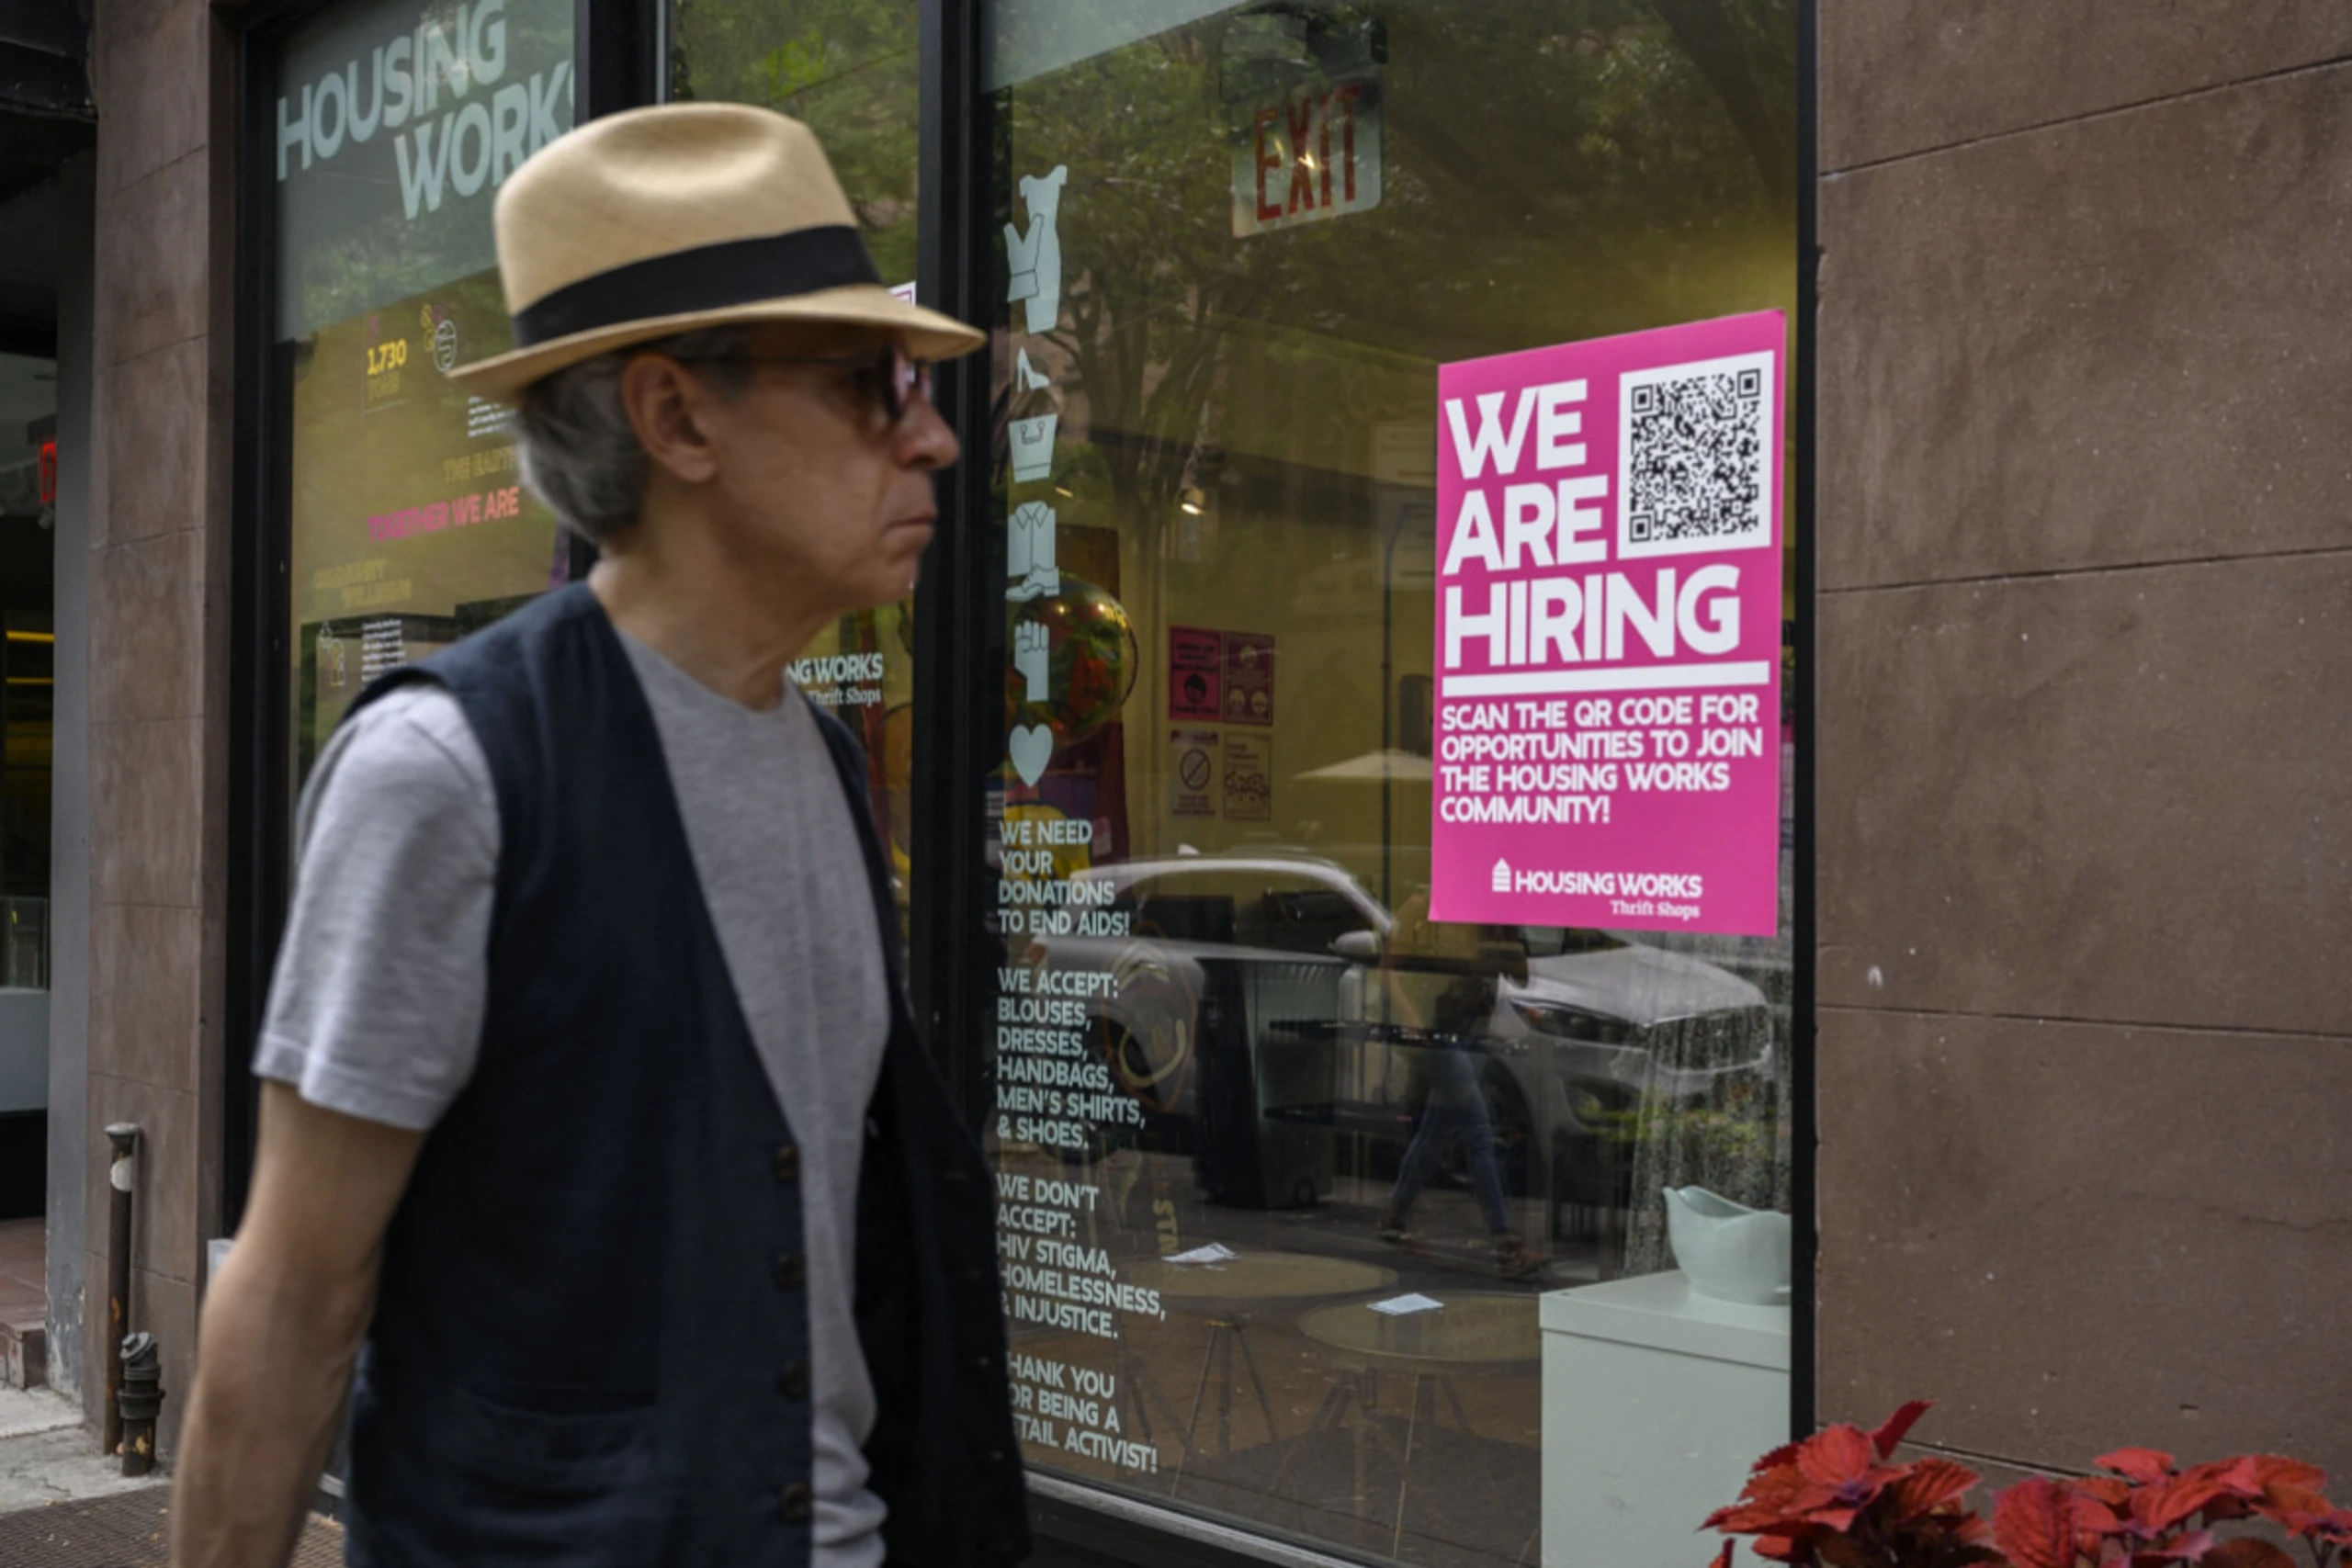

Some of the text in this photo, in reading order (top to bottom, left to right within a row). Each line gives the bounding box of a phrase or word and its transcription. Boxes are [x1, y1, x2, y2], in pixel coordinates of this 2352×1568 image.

[277, 0, 506, 182] HOUSING
[394, 61, 574, 220] WORK
[1254, 84, 1361, 221] EXIT
[1444, 378, 1588, 480] WE
[452, 494, 482, 526] WE
[484, 486, 520, 521] ARE
[1442, 474, 1608, 575] ARE
[1444, 564, 1740, 669] HIRING
[815, 651, 883, 683] WORKS
[846, 687, 881, 707] Shops
[1442, 694, 1758, 730] SCAN THE QR CODE FOR
[1441, 728, 1762, 761] OPPORTUNITIES TO JOIN
[1441, 762, 1730, 792] THE HOUSING WORKS
[1441, 795, 1610, 823] COMMUNITY!
[999, 820, 1092, 845] WE NEED
[1000, 851, 1053, 875] YOUR
[999, 880, 1114, 906] DONATIONS
[1515, 871, 1702, 898] HOUSING WORKS
[998, 909, 1130, 936] TO END AIDS!
[1611, 900, 1700, 921] Thrift Shops
[998, 967, 1118, 998] WE ACCEPT:
[998, 998, 1091, 1030] BLOUSES,
[998, 1027, 1088, 1059] DRESSES,
[997, 1055, 1114, 1093] HANDBAGS,
[1067, 1094, 1146, 1128] SHIRTS,
[997, 1114, 1089, 1149] & SHOES.
[997, 1172, 1029, 1198] WE
[996, 1203, 1076, 1237] ACCEPT:
[996, 1233, 1116, 1280] HIV STIGMA,
[1015, 1295, 1118, 1338] INJUSTICE.
[1007, 1351, 1114, 1398] HANK YOU
[1038, 1389, 1098, 1425] BEING
[1104, 1407, 1120, 1432] A
[1065, 1427, 1158, 1473] ACTIVIST!
